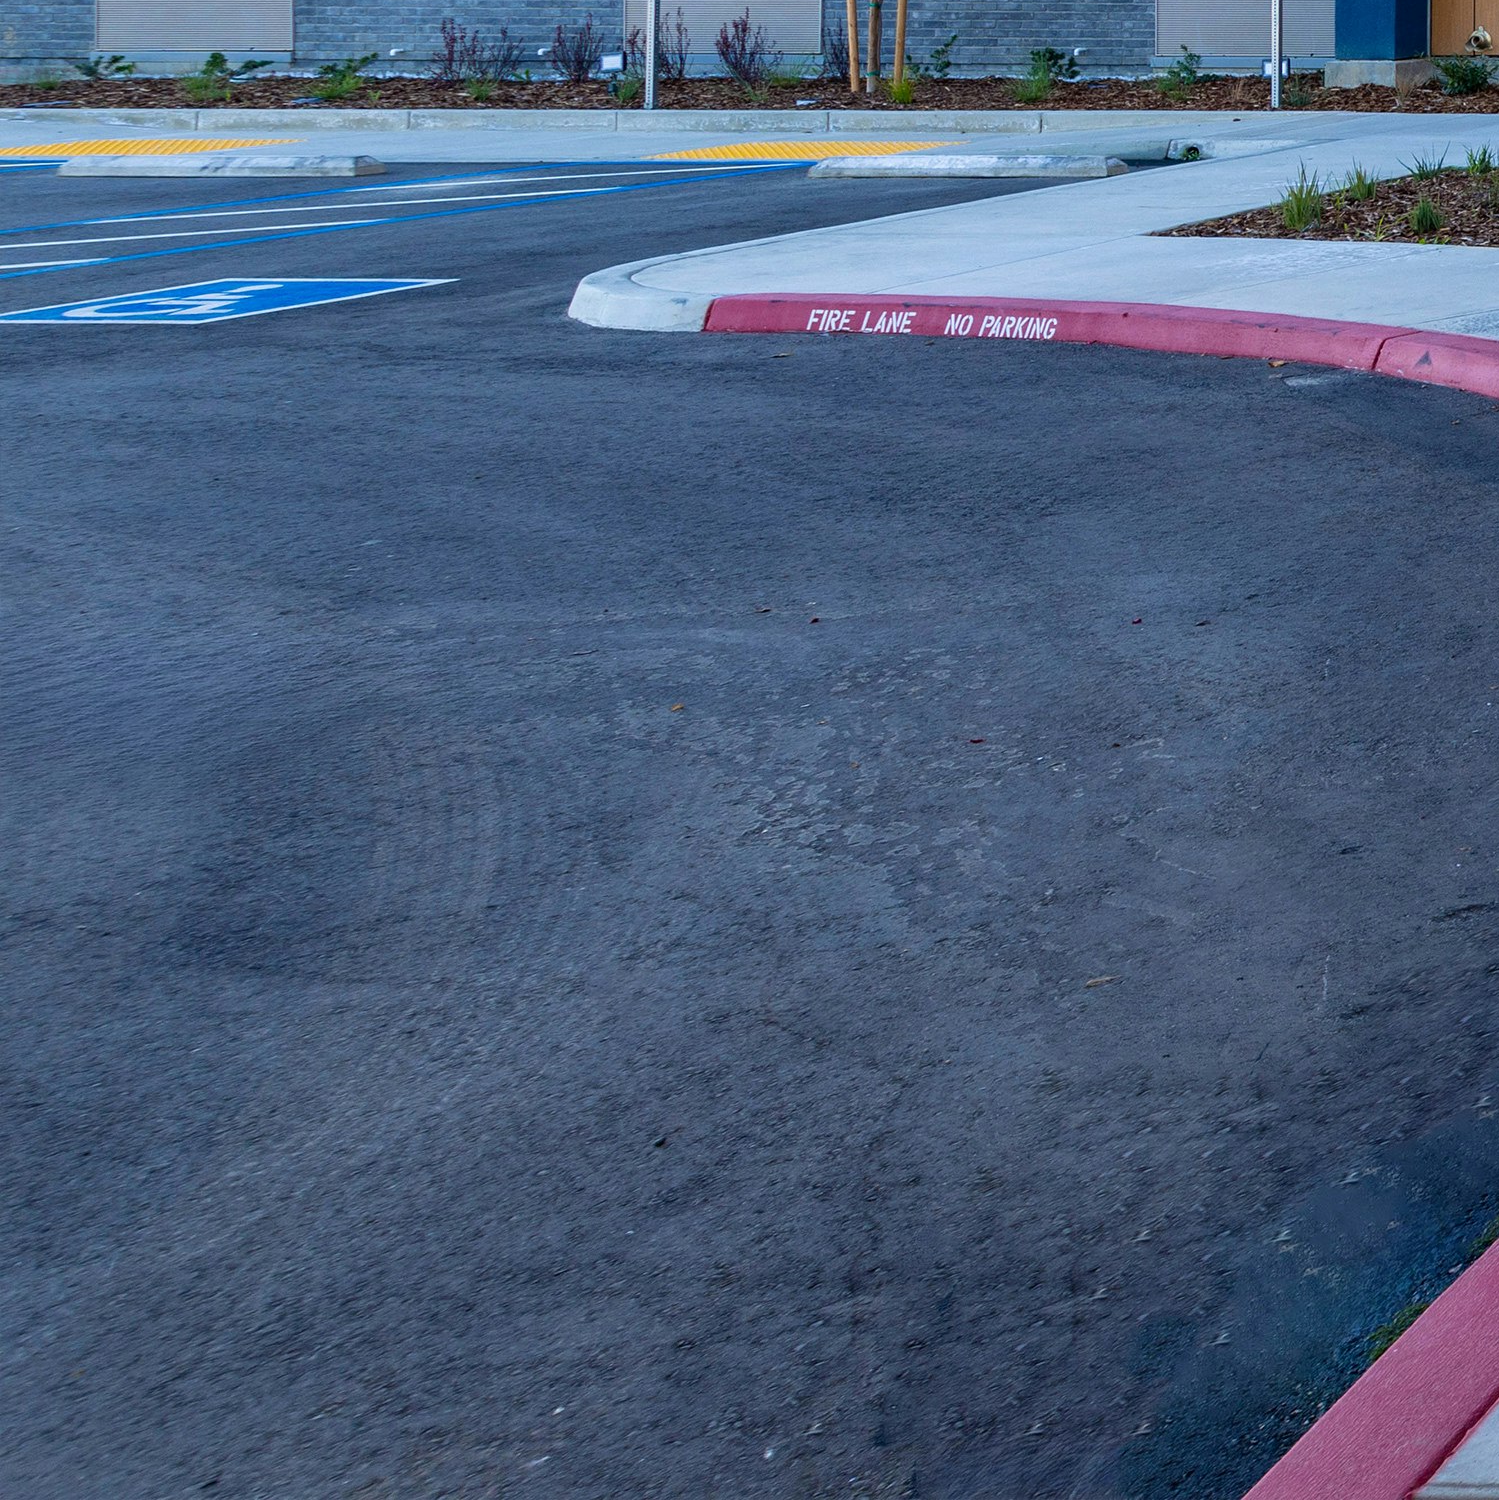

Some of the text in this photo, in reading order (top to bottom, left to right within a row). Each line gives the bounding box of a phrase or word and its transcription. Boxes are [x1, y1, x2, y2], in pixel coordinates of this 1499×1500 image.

[806, 309, 1058, 340] FIRE LANE NO PARKING
